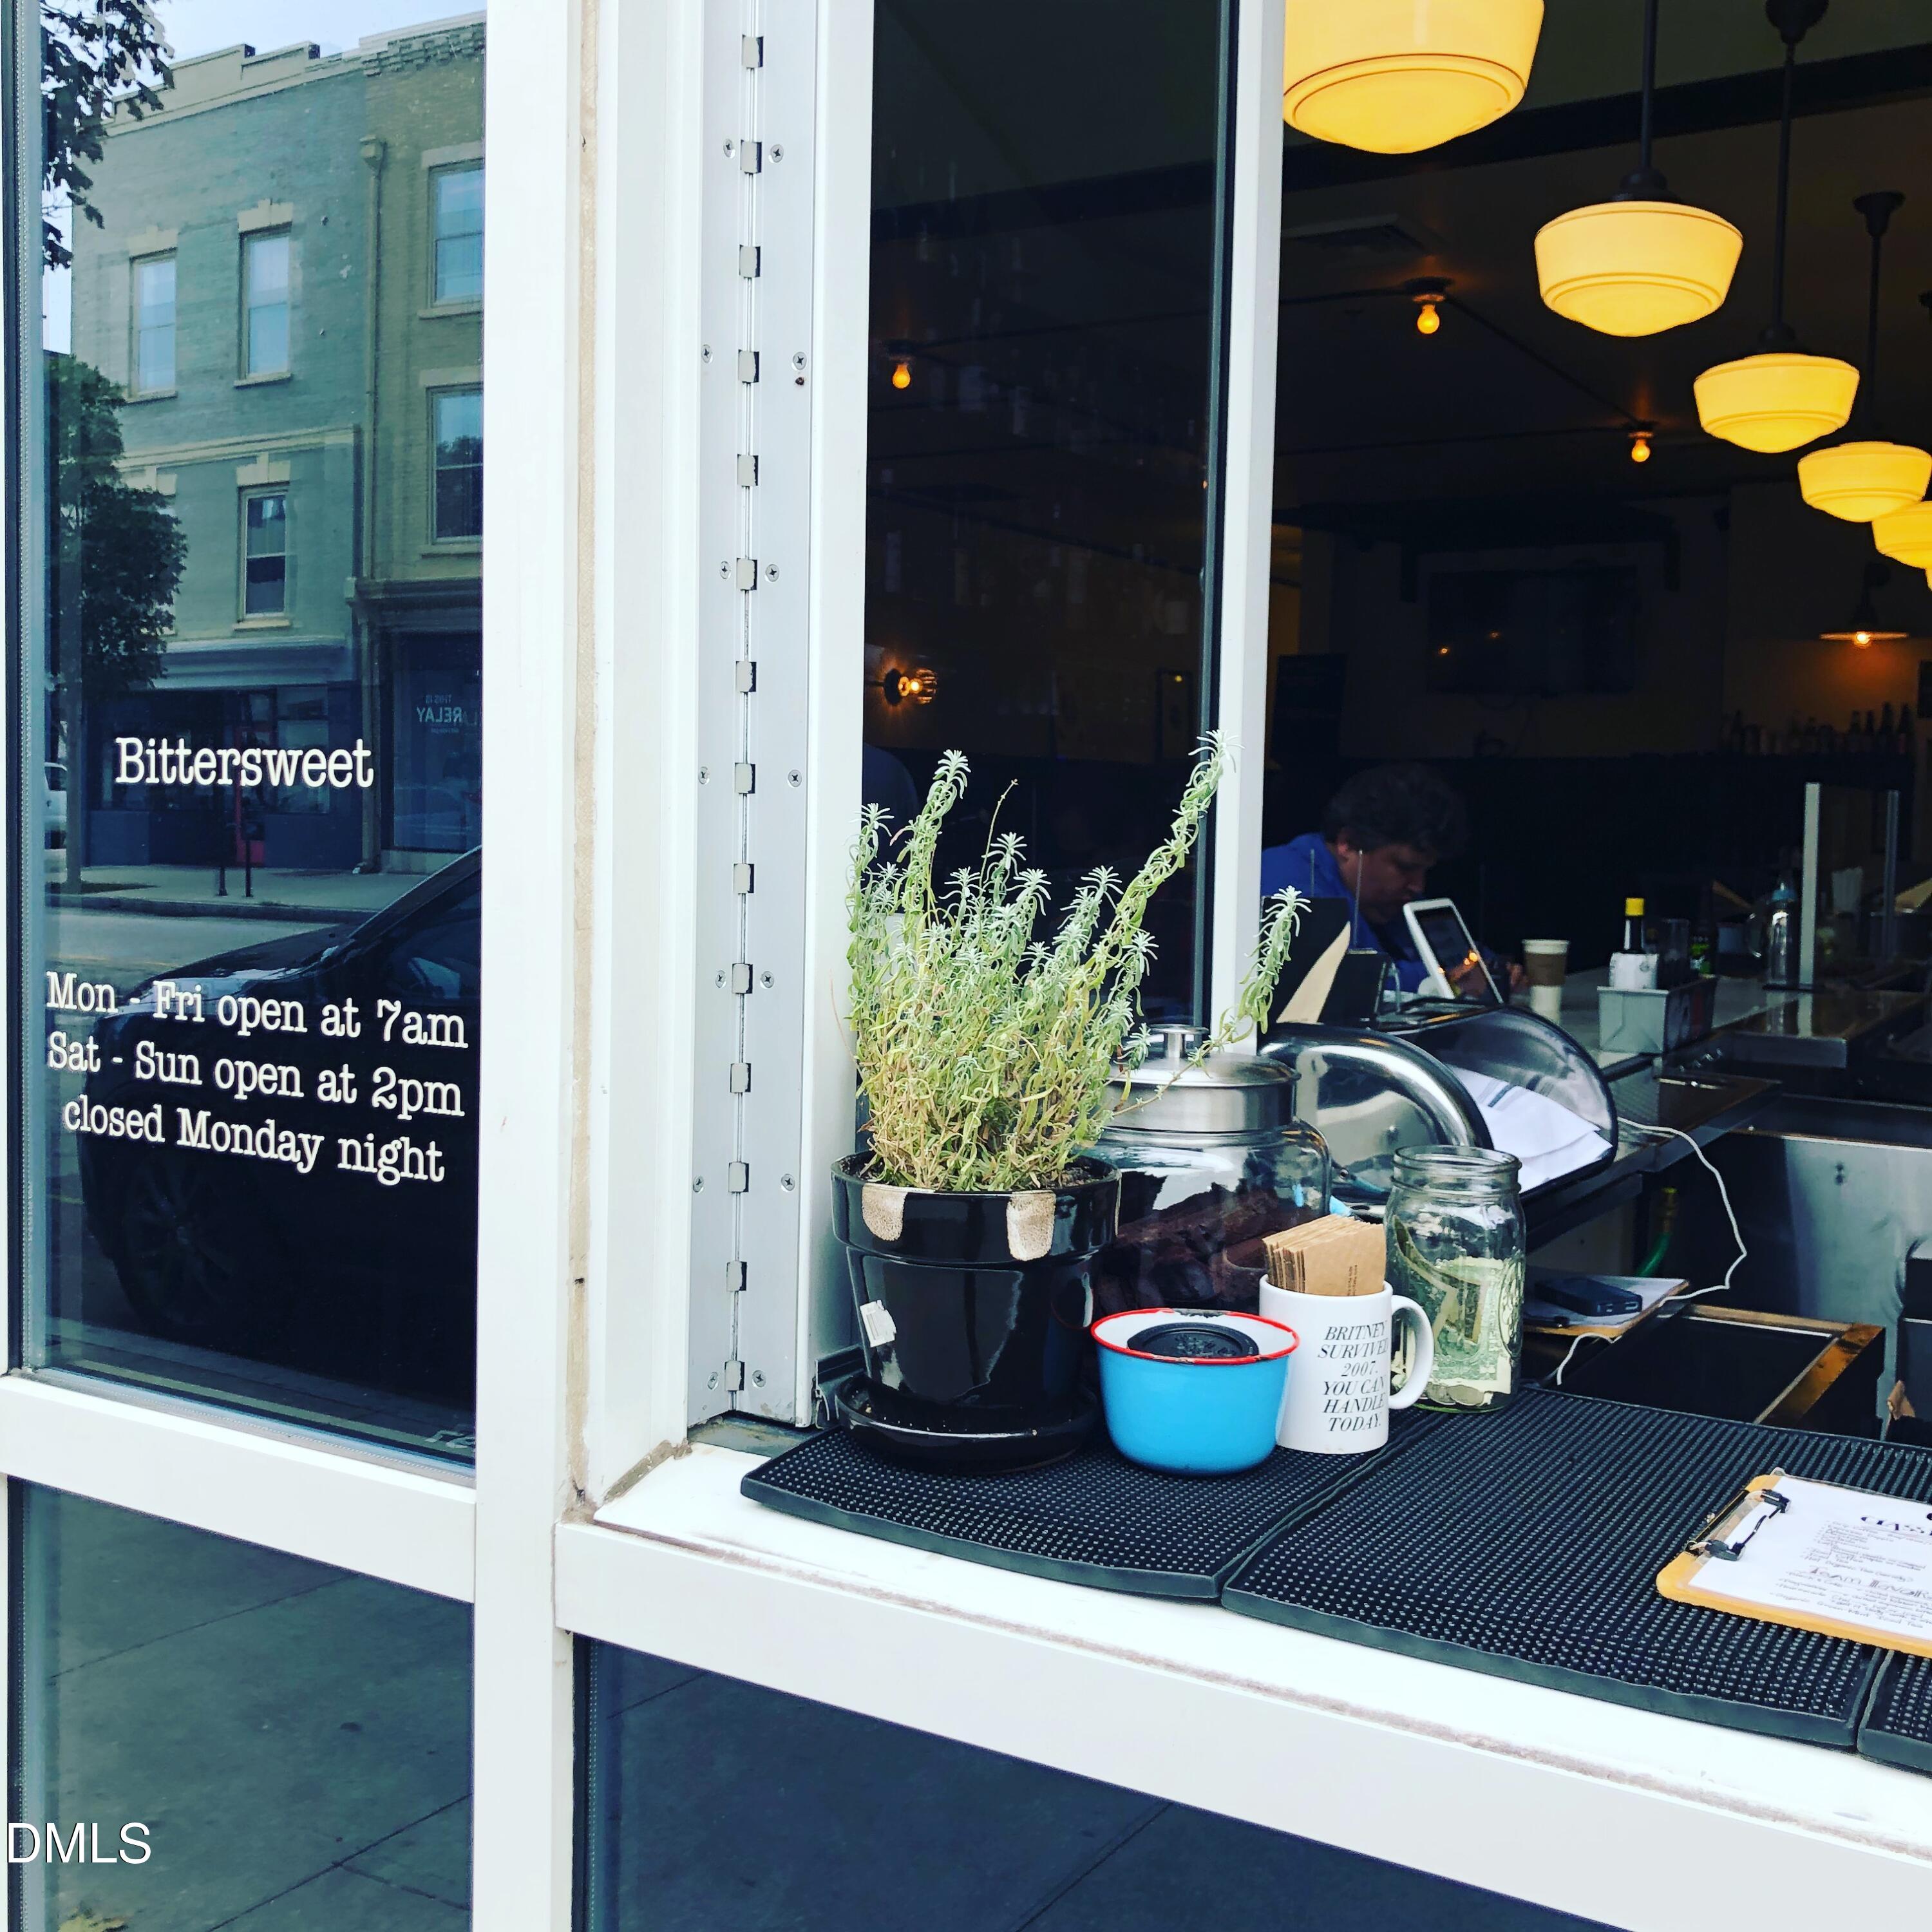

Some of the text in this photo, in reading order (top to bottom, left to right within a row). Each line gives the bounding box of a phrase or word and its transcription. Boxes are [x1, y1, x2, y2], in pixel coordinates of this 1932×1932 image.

[115, 736, 374, 788] Bittersweet
[46, 971, 119, 1014] Mon
[152, 980, 205, 1023] Fri
[217, 995, 307, 1037] open
[321, 999, 361, 1037] at
[377, 998, 469, 1048] 7am
[48, 1031, 101, 1073] Sat
[135, 1040, 203, 1085] Sun
[214, 1058, 305, 1101] open
[317, 1063, 357, 1104] at
[372, 1066, 466, 1121] 2pm
[63, 1094, 445, 1186] closed Monday night
[1324, 1321, 1387, 1341] BRITNEY
[1341, 1360, 1378, 1377] 2007.
[1323, 1375, 1386, 1396] YOU CAN
[1322, 1392, 1386, 1414] HANDLE
[1329, 1412, 1383, 1432] TODAY.
